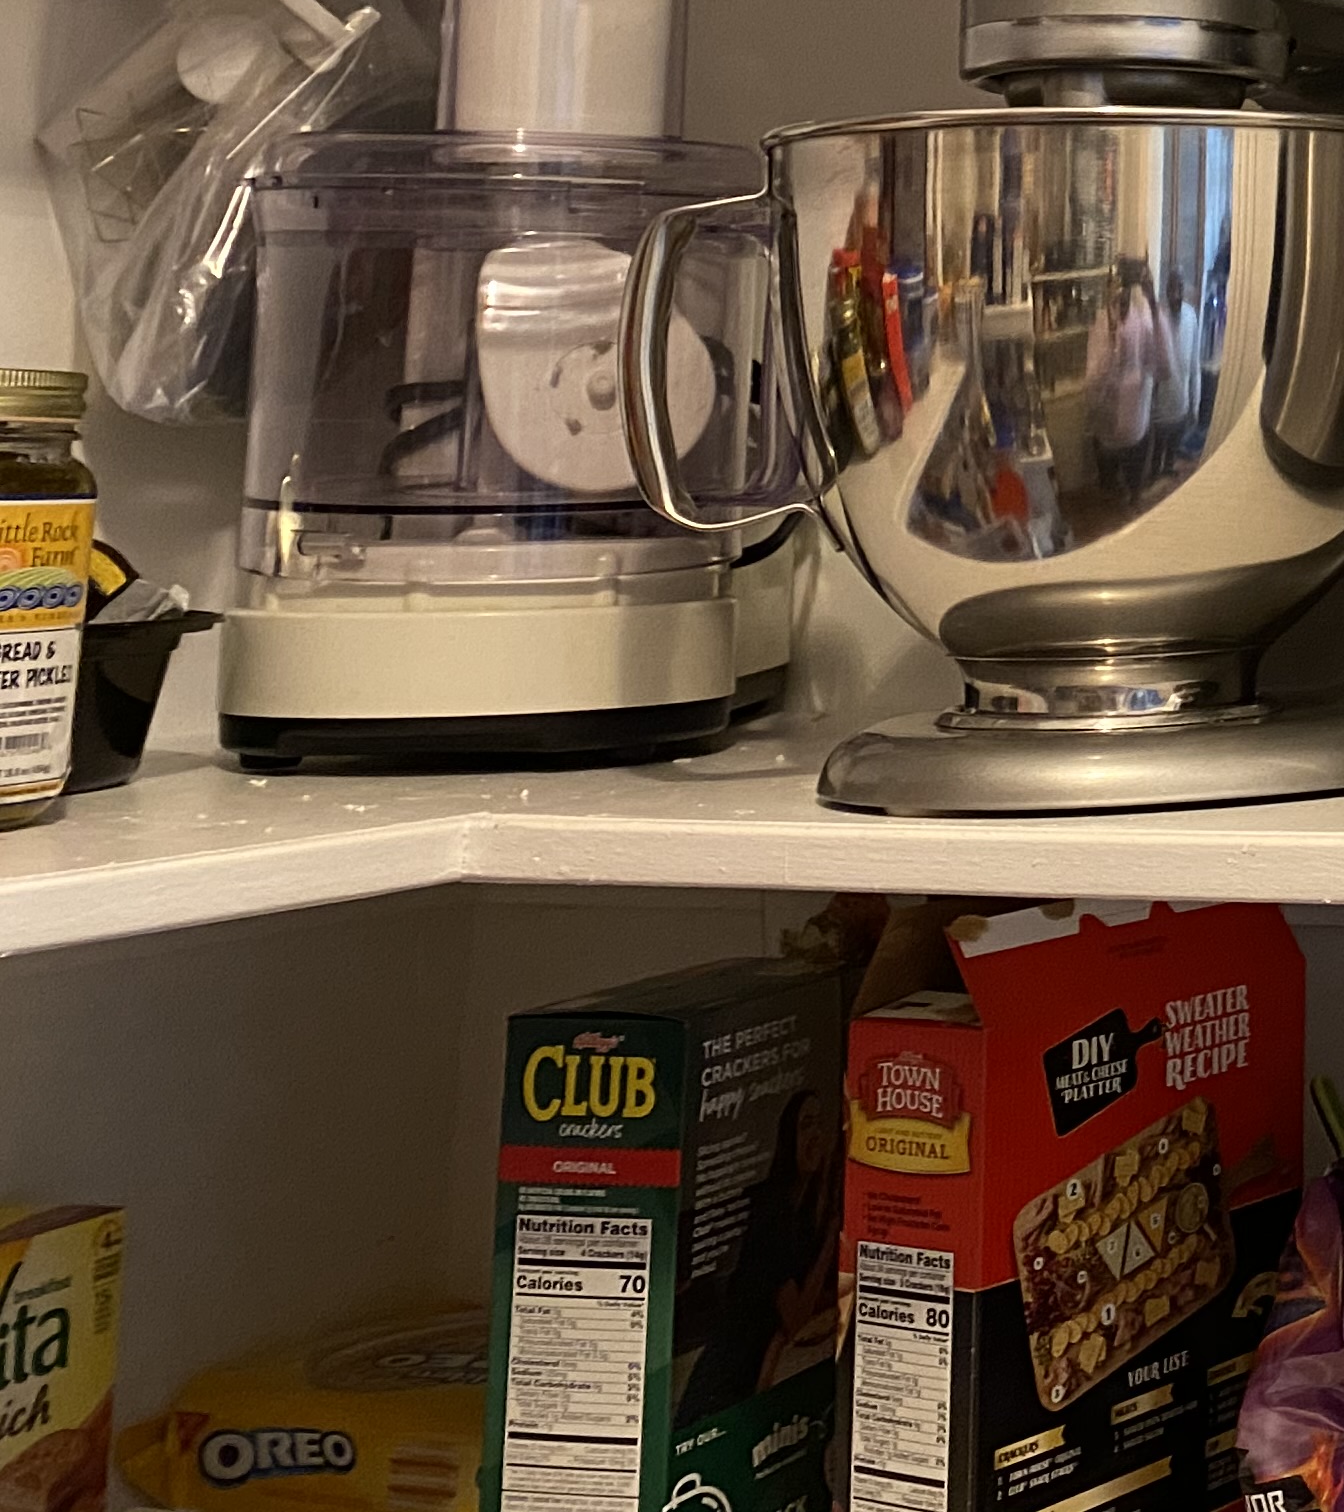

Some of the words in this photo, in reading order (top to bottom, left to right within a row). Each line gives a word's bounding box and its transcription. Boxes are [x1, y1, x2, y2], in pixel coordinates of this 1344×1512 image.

[0, 512, 39, 543] ittle
[0, 640, 41, 663] READ
[1165, 984, 1250, 1029] SWEATER
[702, 1033, 732, 1059] THE
[735, 1015, 797, 1049] PERFECT
[1165, 1011, 1251, 1058] WEATHER
[701, 1046, 780, 1087] CRACKERS
[1071, 1032, 1115, 1070] DIY
[1165, 1038, 1250, 1091] RECIPE
[523, 1044, 657, 1122] CLUB
[877, 1061, 943, 1091] TOWN
[1060, 1076, 1122, 1104] PLATTER
[876, 1087, 945, 1119] HOUSE
[558, 1117, 625, 1139] crackers
[866, 1136, 950, 1160] ORIGINAL
[553, 1160, 618, 1175] ORIGINAL
[518, 1217, 595, 1234] Nutrition
[600, 1220, 649, 1236] Facts
[859, 1244, 913, 1265] Nutrition
[916, 1252, 951, 1270] Facts
[516, 1274, 584, 1293] Calories
[619, 1274, 646, 1294] 70
[859, 1302, 915, 1324] Calories
[926, 1307, 950, 1328] 80
[1127, 1361, 1161, 1387] YOUR
[1163, 1349, 1189, 1374] LIST
[202, 1431, 353, 1481] OREO
